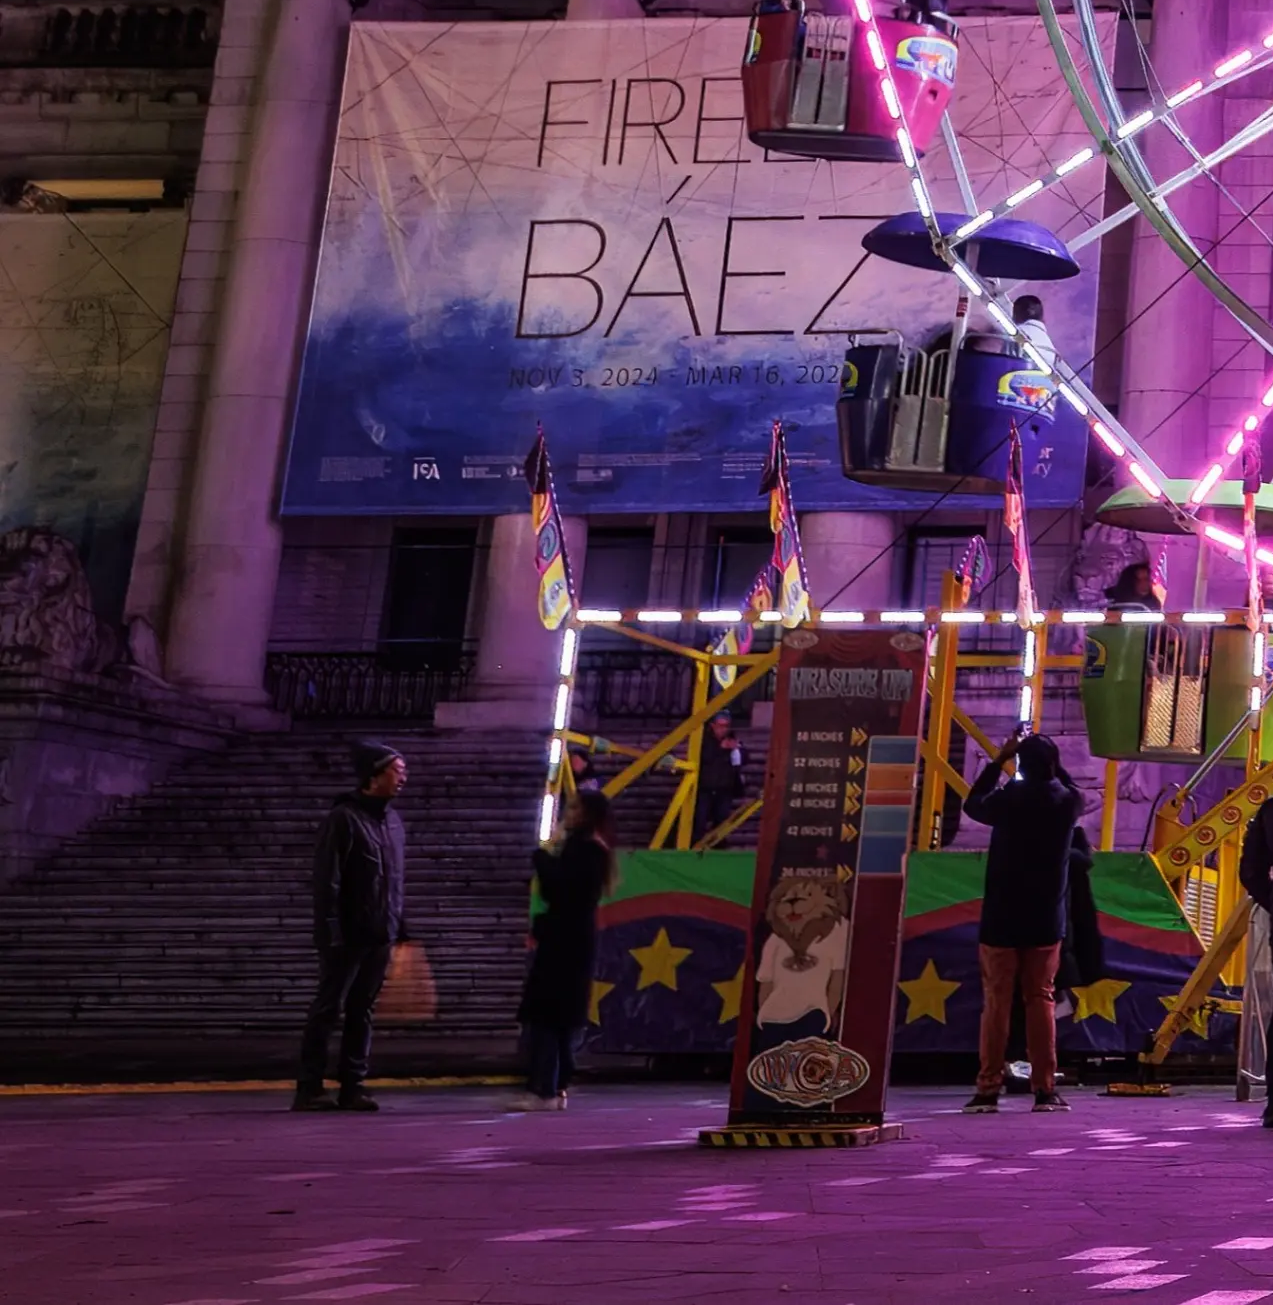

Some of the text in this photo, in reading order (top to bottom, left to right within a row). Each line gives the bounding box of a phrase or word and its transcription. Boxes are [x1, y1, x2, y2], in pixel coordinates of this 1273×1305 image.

[514, 175, 905, 339] BÁEZ
[509, 368, 563, 388] NOV
[601, 367, 657, 386] 2024
[686, 366, 742, 385] MAR
[795, 364, 841, 385] 202
[789, 667, 879, 700] MEASURE
[810, 731, 844, 742] INCHES
[808, 757, 841, 768] INCHES
[804, 783, 838, 793] INCHES
[803, 798, 836, 809] INCHES
[800, 826, 833, 837] INCHES
